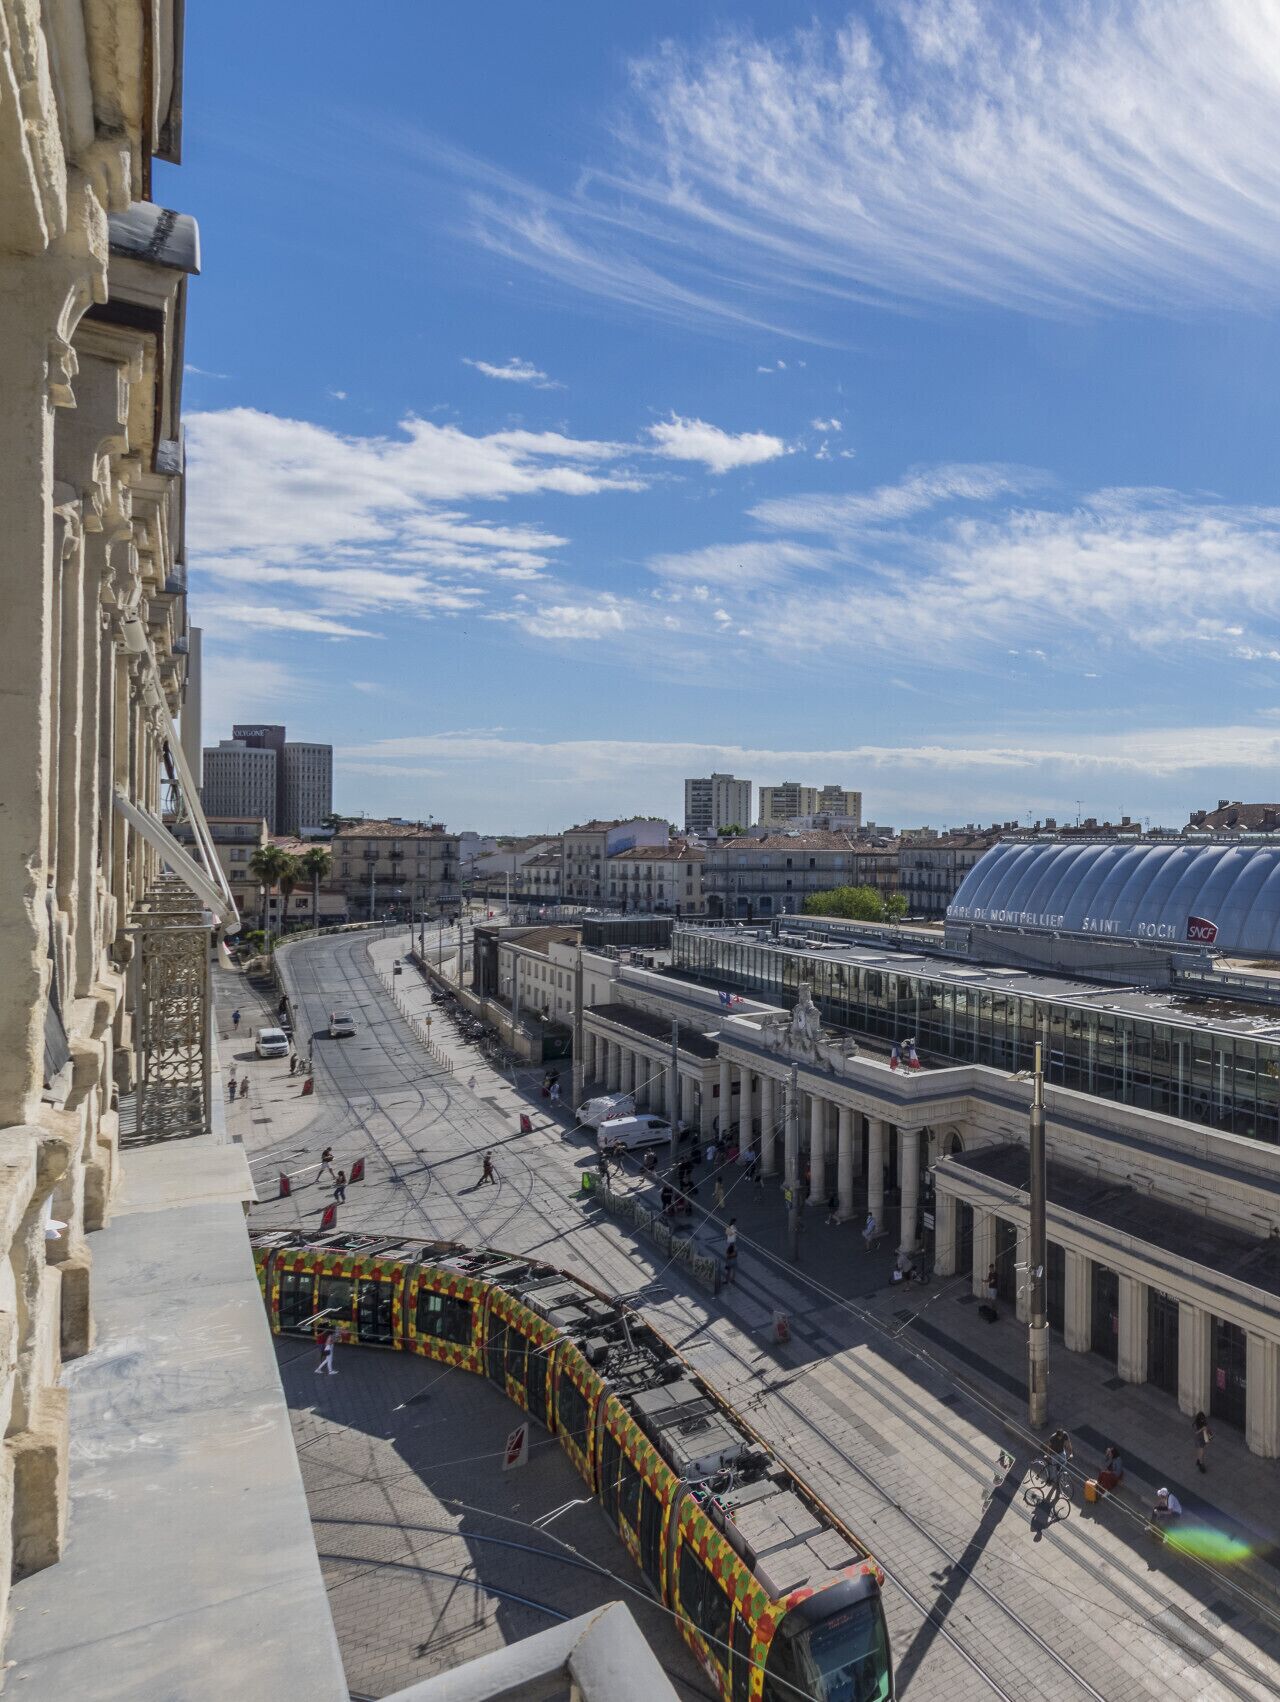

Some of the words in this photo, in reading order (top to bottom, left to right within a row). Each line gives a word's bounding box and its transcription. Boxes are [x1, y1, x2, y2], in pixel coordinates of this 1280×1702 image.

[946, 904, 971, 919] GARE
[974, 907, 987, 920] DE
[990, 909, 1064, 928] MONTPELLIER
[1082, 917, 1121, 934] SAINT
[1138, 922, 1177, 939] ROCH
[1188, 926, 1214, 940] SNCF
